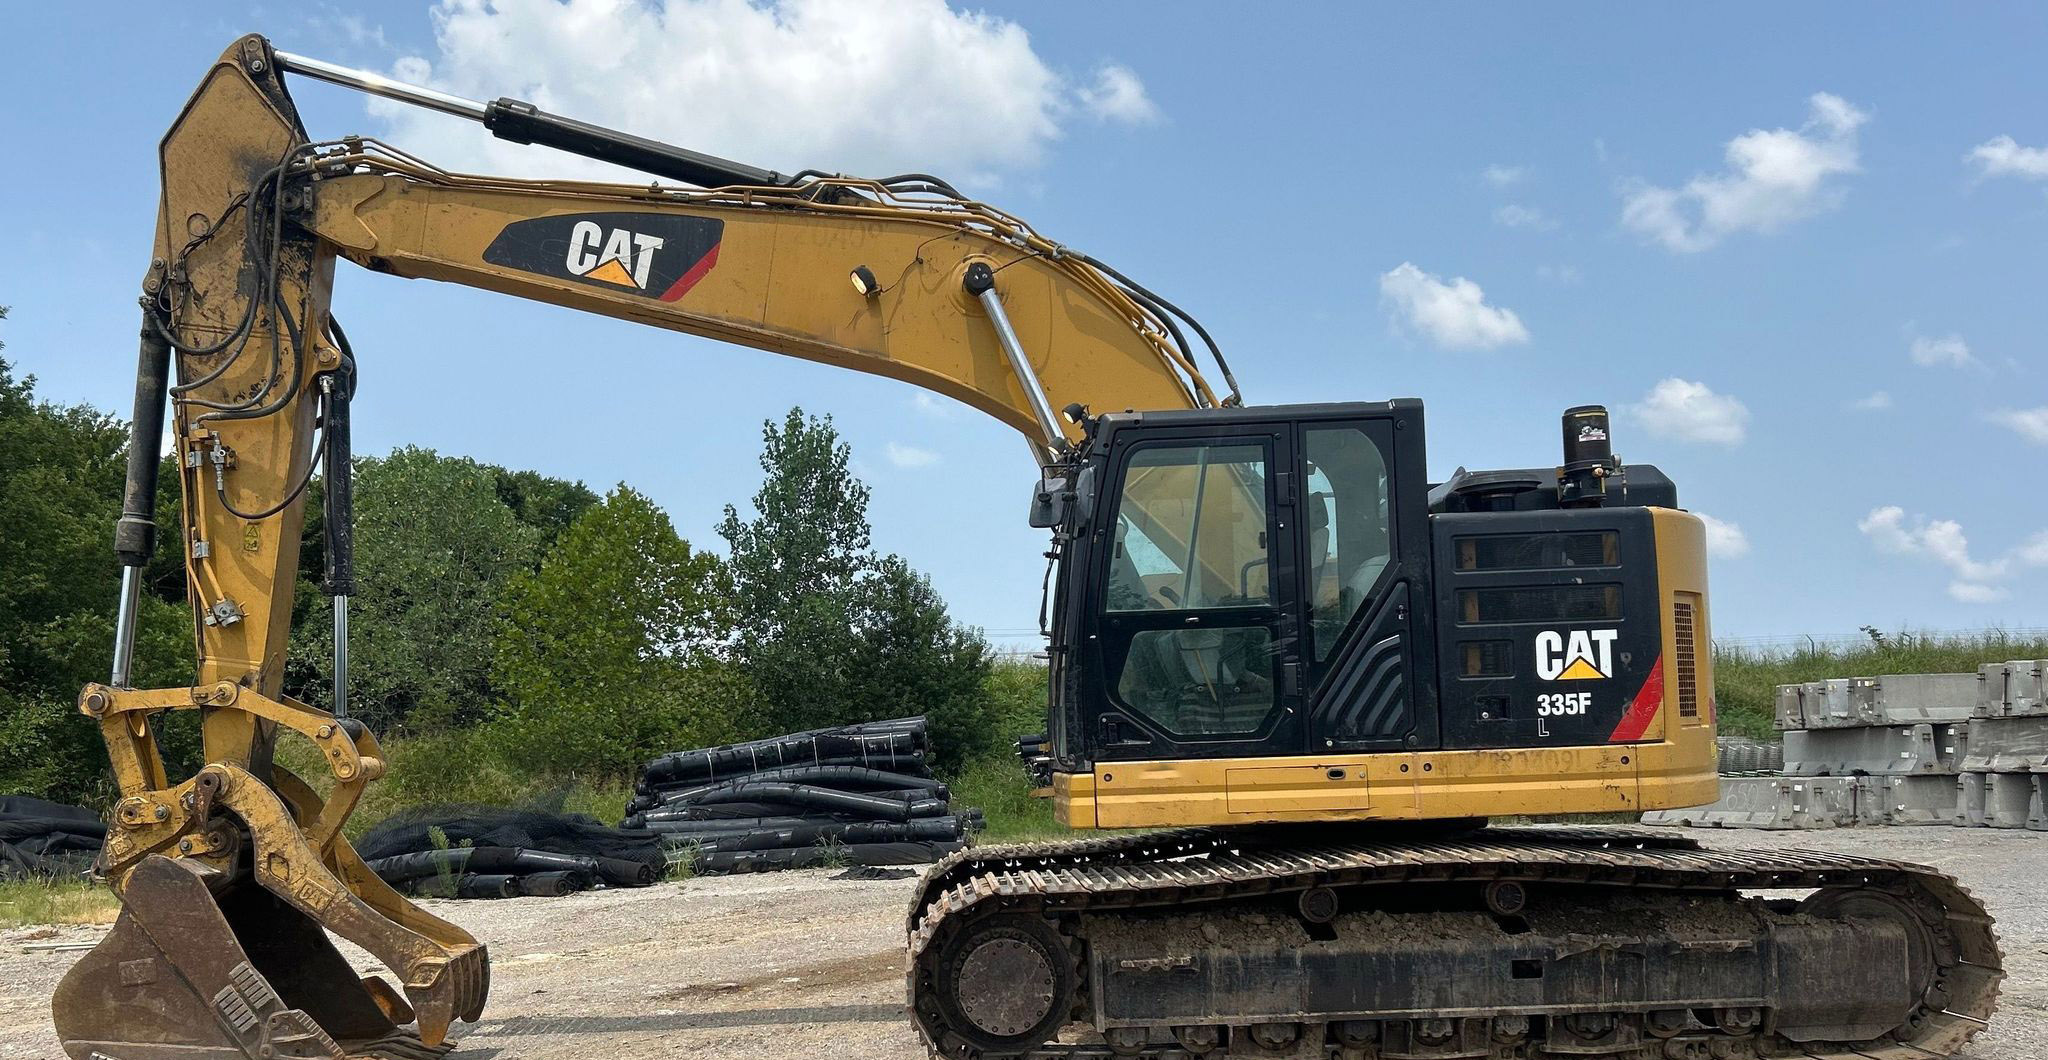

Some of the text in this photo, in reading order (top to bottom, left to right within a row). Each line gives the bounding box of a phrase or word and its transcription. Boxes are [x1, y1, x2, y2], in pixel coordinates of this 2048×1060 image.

[566, 220, 664, 290] CAT
[1535, 629, 1618, 681] CAT
[1537, 692, 1592, 717] 335F
[1538, 718, 1550, 737] L
